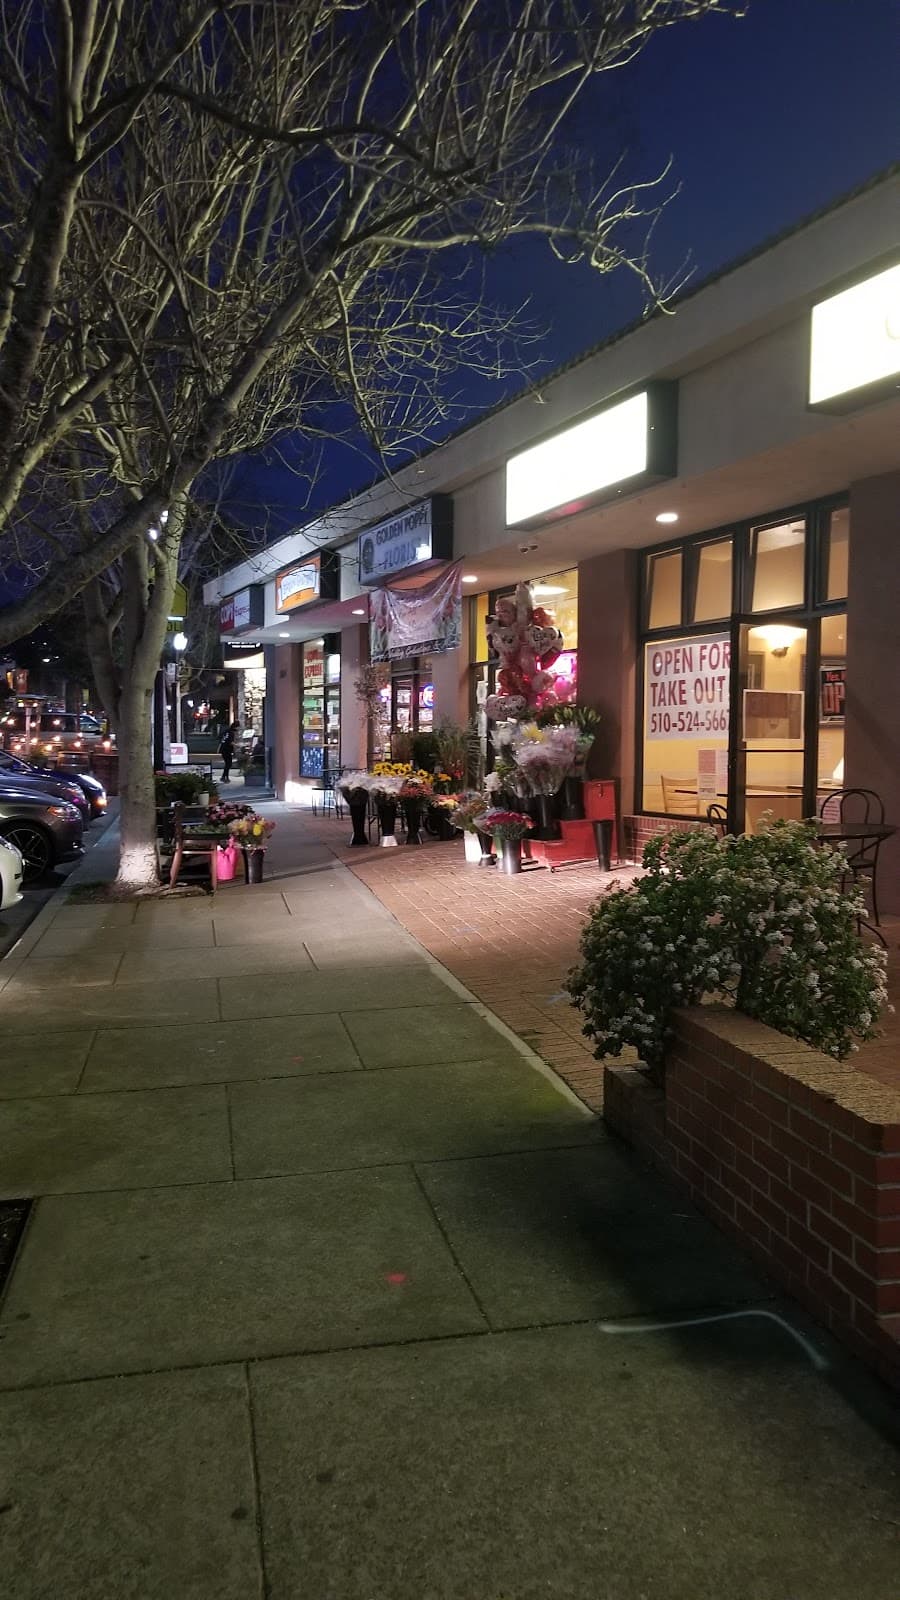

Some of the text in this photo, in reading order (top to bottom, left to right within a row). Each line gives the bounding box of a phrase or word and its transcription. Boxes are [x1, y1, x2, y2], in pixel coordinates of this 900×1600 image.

[376, 510, 428, 545] GOLDEN POPPY
[652, 641, 731, 677] OPEN FOR
[650, 675, 726, 708] TAKE OUT
